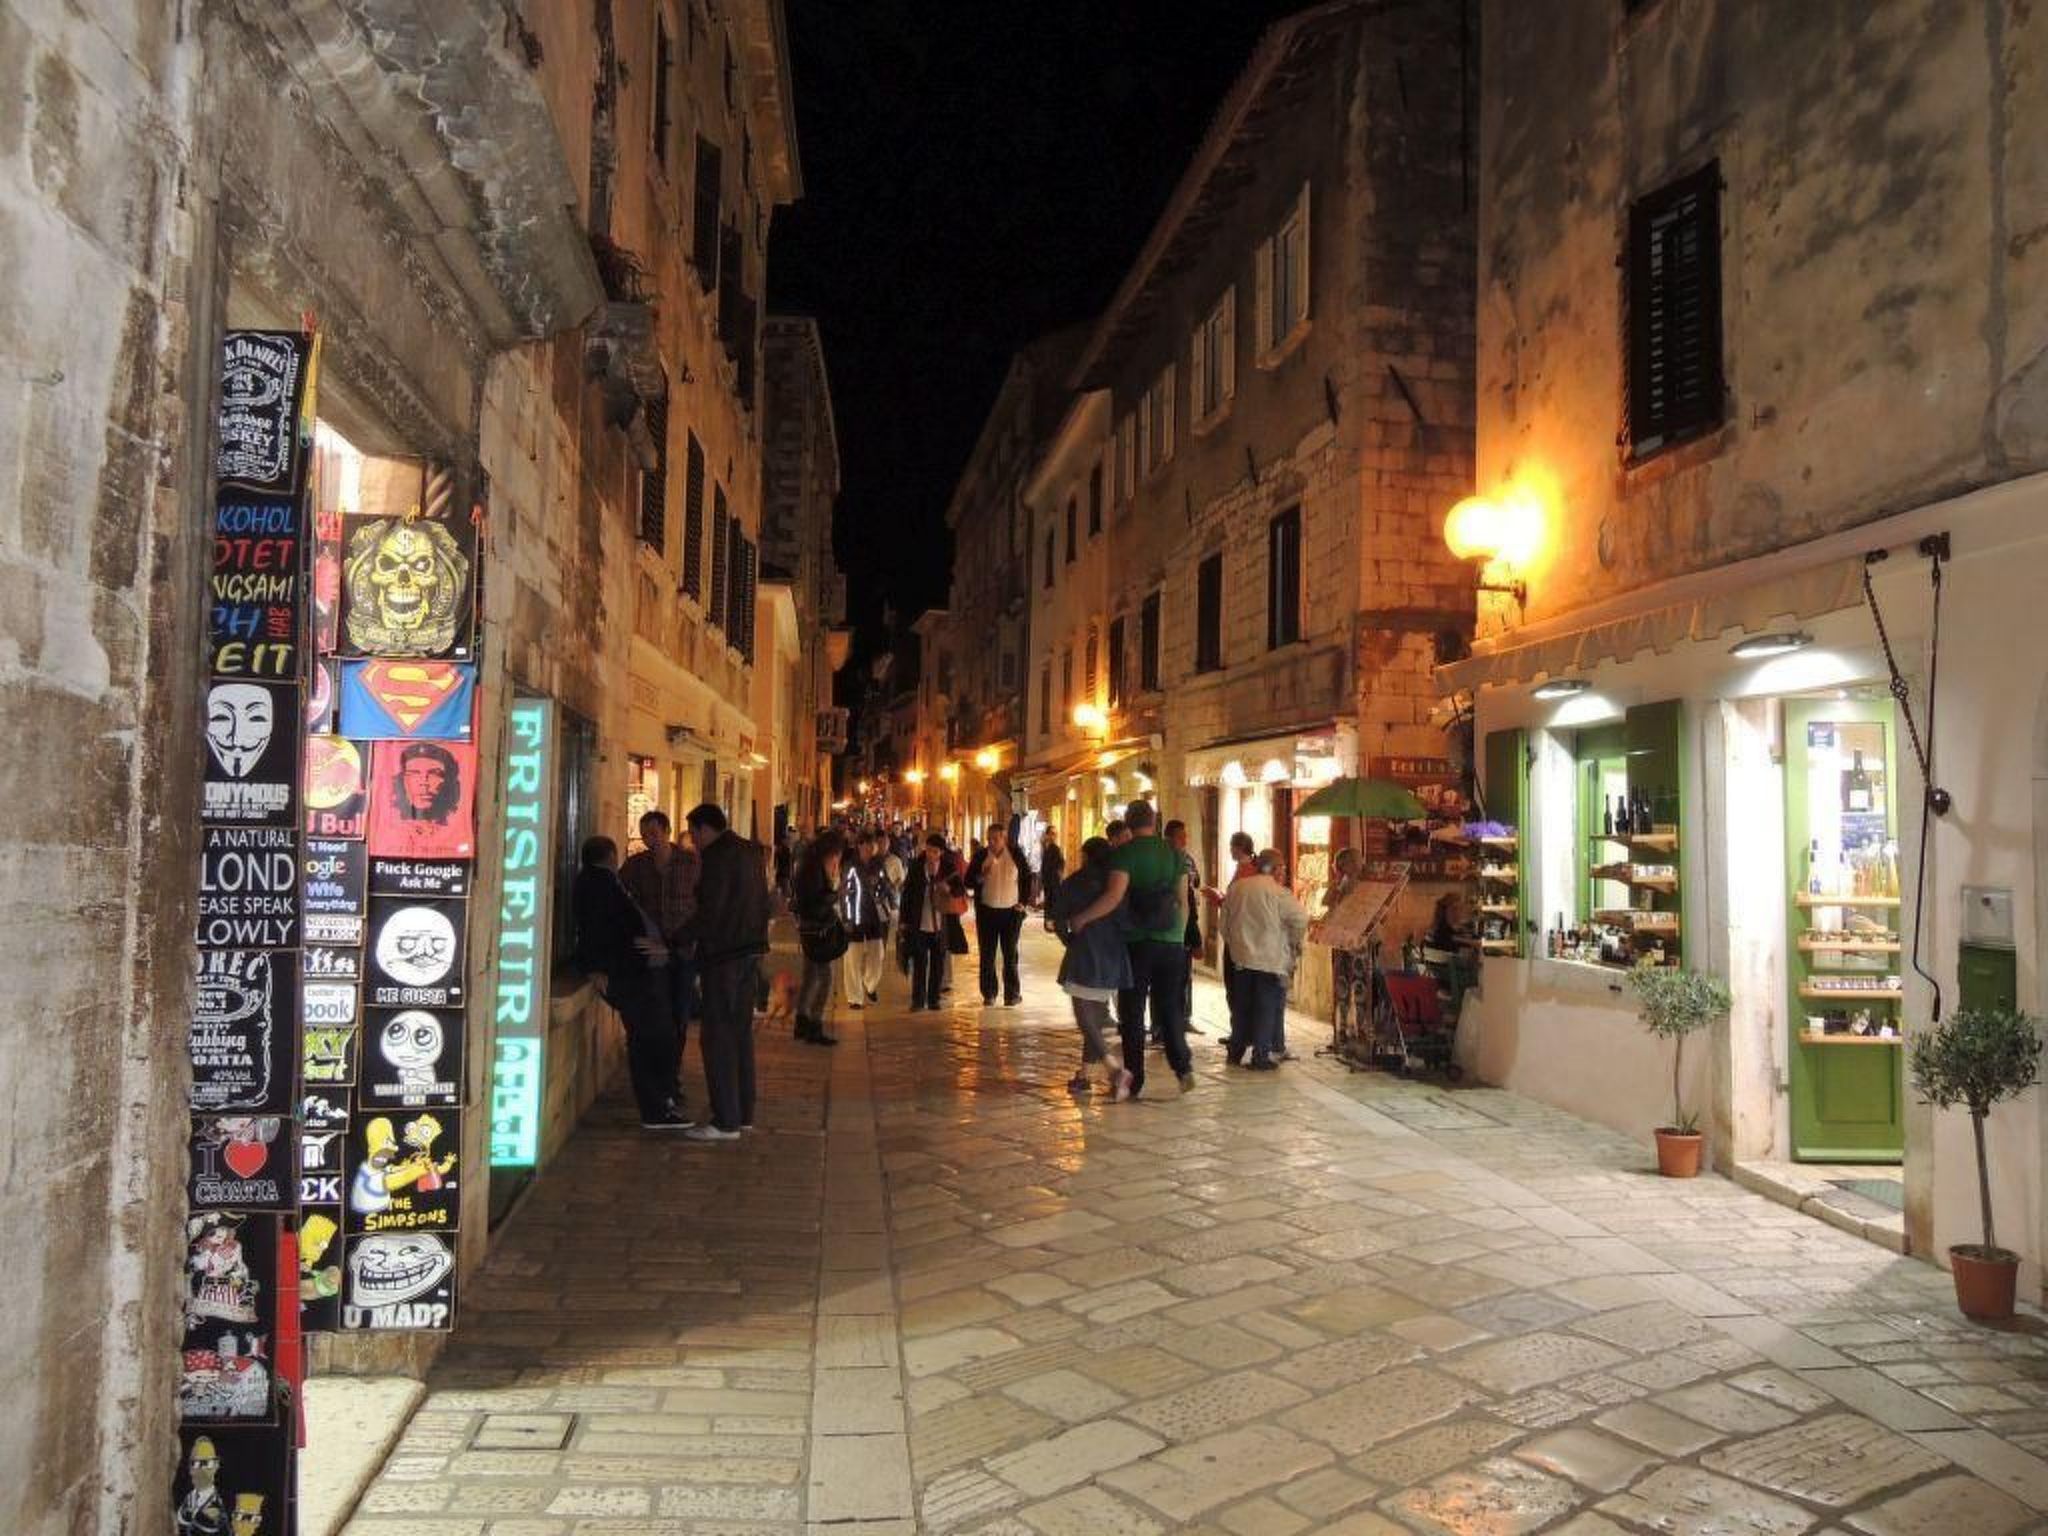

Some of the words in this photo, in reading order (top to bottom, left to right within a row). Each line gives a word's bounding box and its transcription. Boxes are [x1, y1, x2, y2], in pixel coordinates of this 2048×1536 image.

[217, 505, 295, 534] KOHOL
[209, 830, 221, 848] A
[225, 830, 295, 848] NATURAL
[201, 852, 295, 892] LOND
[375, 861, 411, 875] Fuck
[415, 863, 463, 880] Google
[496, 705, 543, 1026] FRISEUR
[199, 897, 239, 915] EASE
[243, 897, 294, 915] SPEAK
[195, 919, 294, 945] LOWLY
[376, 987, 399, 1003] ME
[401, 988, 447, 1005] GUSTA
[196, 1141, 221, 1181] I
[364, 1209, 448, 1232] SIMPSONS
[344, 1305, 362, 1329] U
[369, 1302, 448, 1329] MAD?
